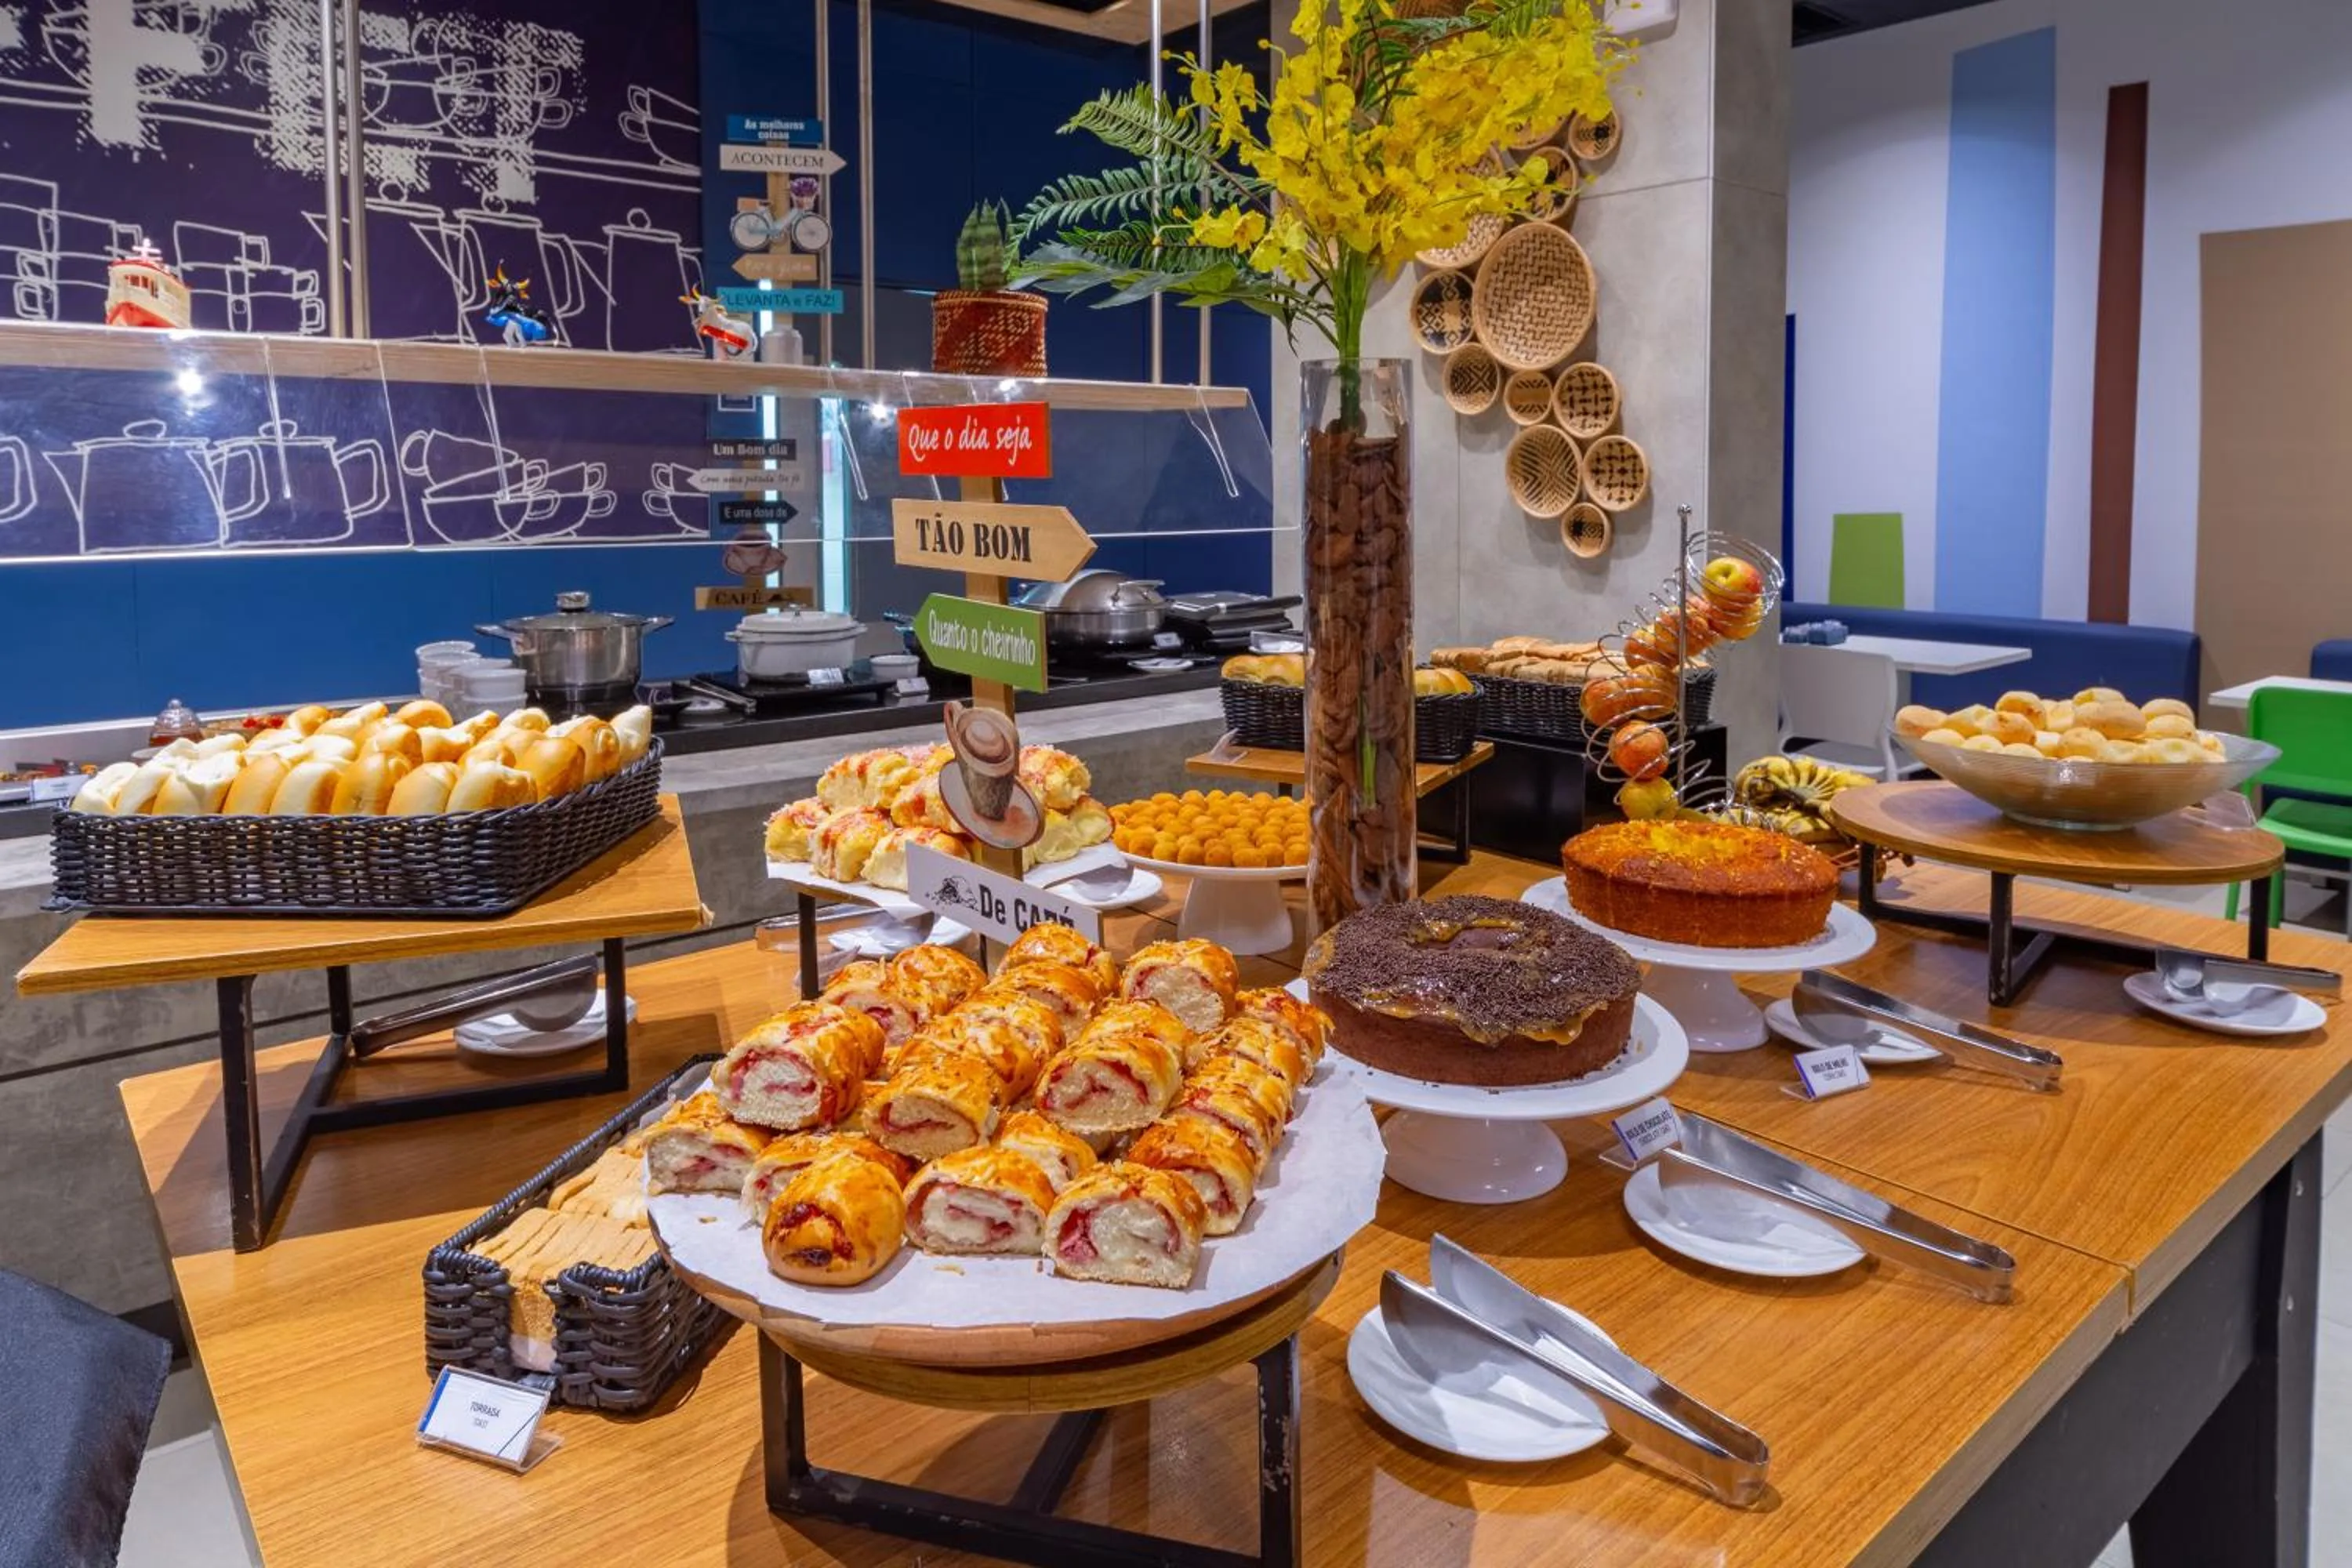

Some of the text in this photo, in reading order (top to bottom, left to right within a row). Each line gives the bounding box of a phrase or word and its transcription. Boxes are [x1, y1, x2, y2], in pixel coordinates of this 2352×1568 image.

[731, 152, 824, 168] ACONTECEM
[728, 294, 790, 307] LEVANTA
[713, 443, 735, 456] Um
[908, 416, 1033, 466] Que o dia seja
[915, 512, 1032, 563] TÃO BOM
[715, 590, 764, 605] CAFÉ
[928, 608, 1036, 666] Quanto o cheirinho
[978, 884, 1007, 925] De
[470, 1401, 501, 1418] TORRADA
